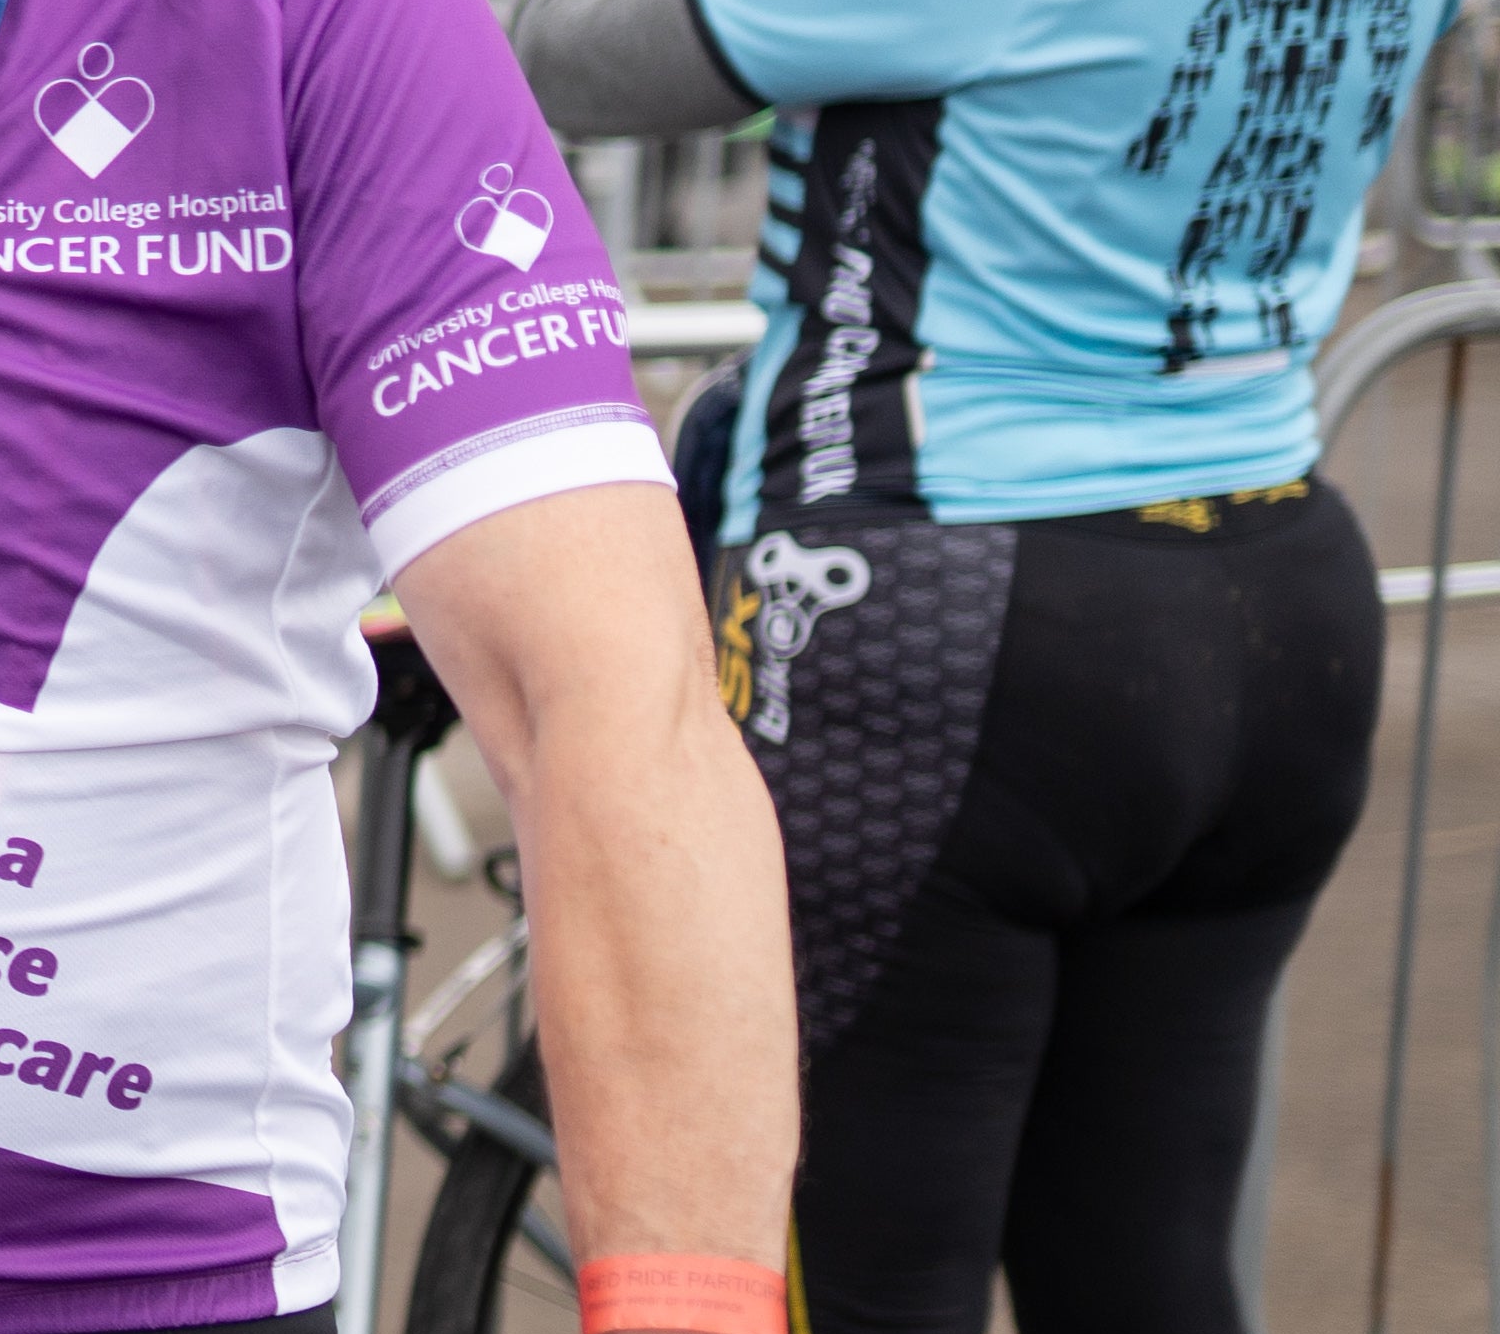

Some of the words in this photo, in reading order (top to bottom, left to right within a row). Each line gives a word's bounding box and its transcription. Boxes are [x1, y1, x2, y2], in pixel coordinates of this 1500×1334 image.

[53, 197, 161, 228] College
[168, 185, 286, 222] Hospital
[137, 227, 293, 276] FUND
[367, 303, 493, 370] University
[499, 282, 589, 313] College
[372, 314, 578, 417] CANCER
[577, 308, 629, 349] FU
[627, 1270, 679, 1287] RIDE
[687, 1271, 786, 1300] PARTICIP
